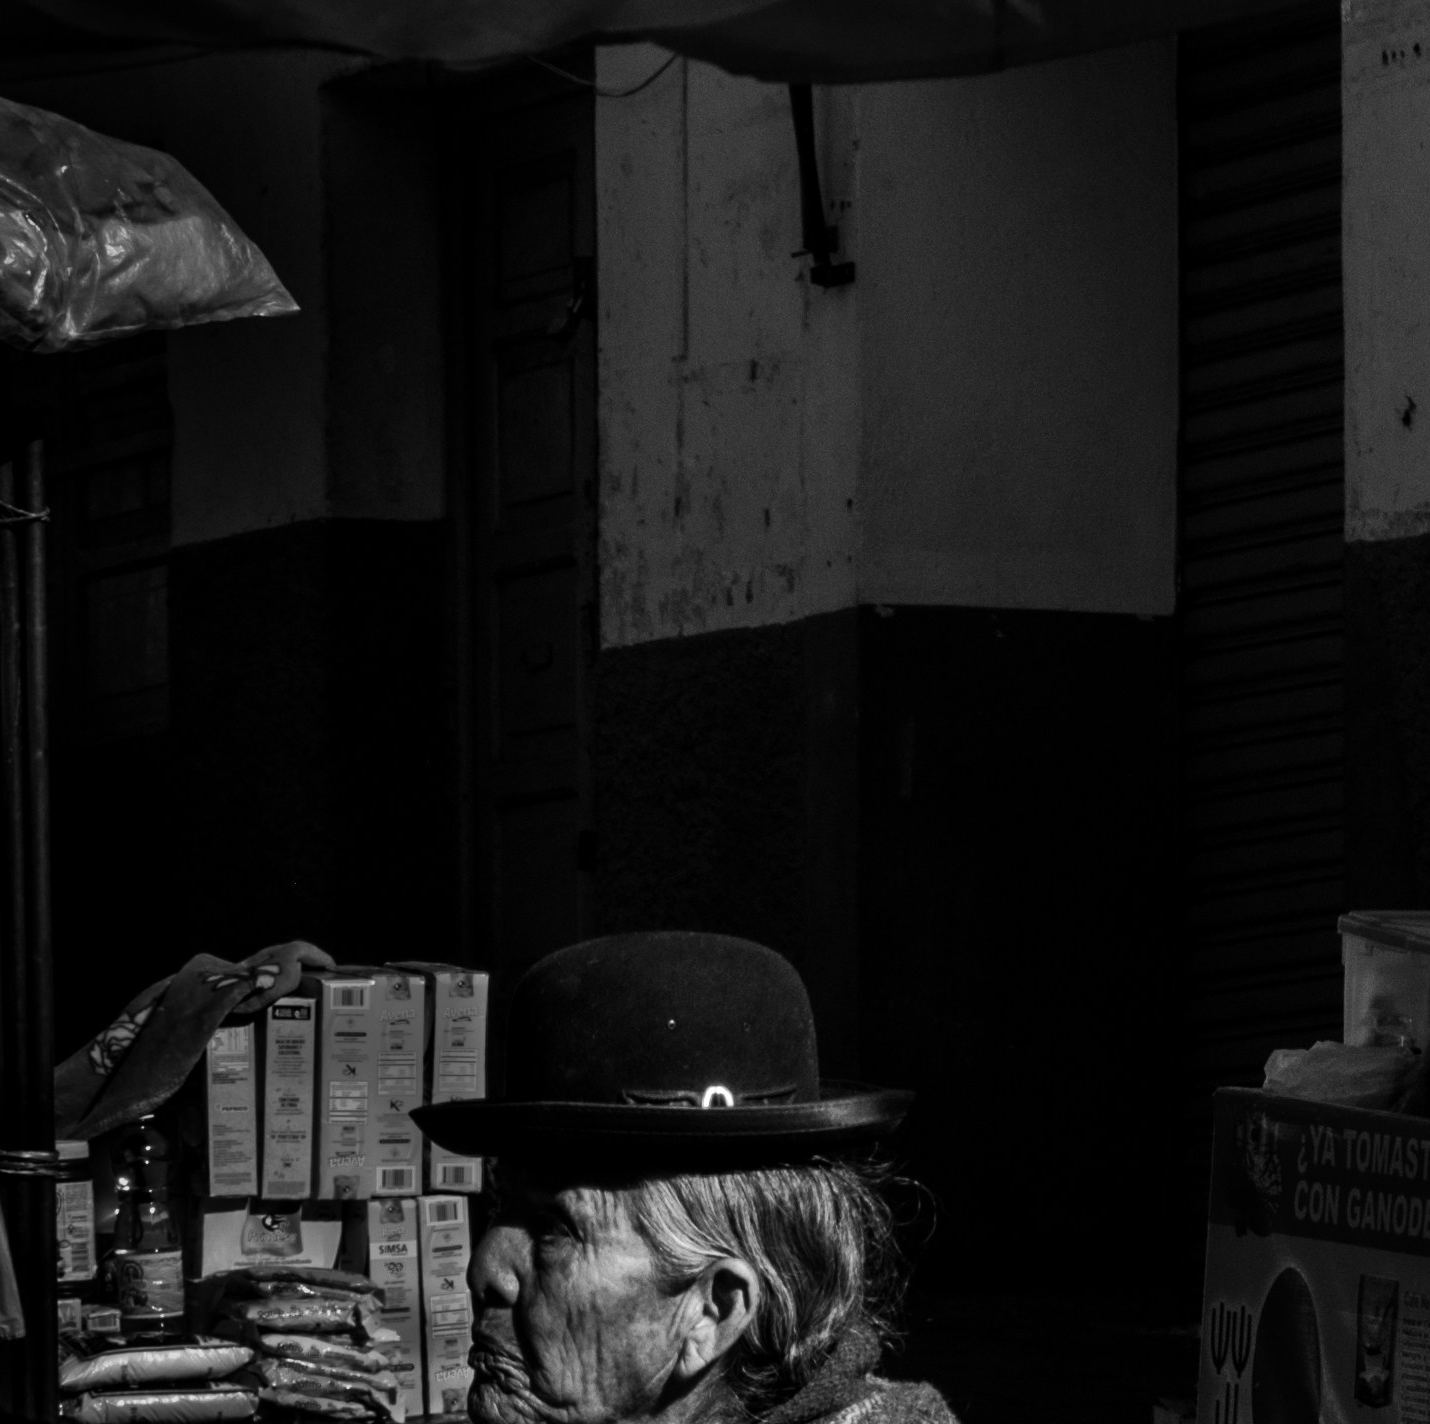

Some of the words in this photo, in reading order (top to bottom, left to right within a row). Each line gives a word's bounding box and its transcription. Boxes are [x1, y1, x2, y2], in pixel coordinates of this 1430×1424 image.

[1295, 1123, 1338, 1172] ¿YA
[1293, 1180, 1340, 1227] CON
[378, 1243, 409, 1254] SIMSA
